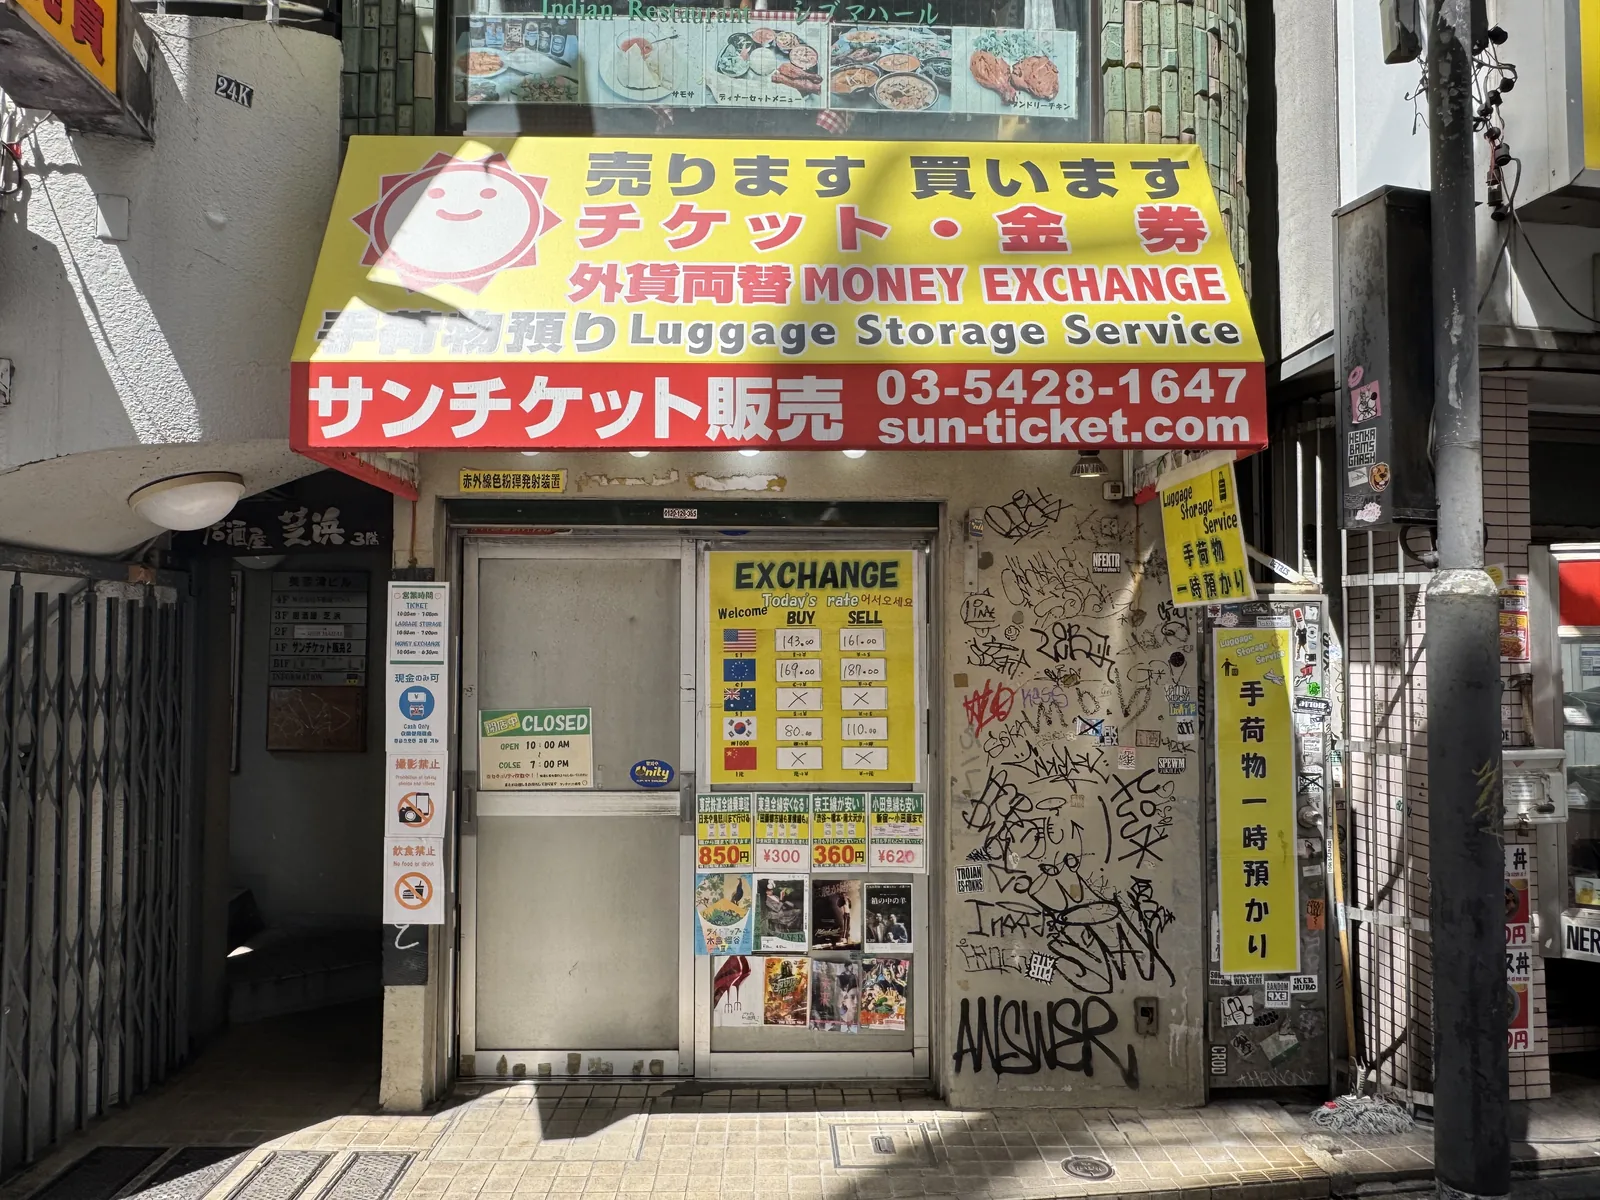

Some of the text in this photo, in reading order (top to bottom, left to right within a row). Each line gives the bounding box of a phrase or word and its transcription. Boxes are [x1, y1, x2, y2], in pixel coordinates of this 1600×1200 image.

[542, 0, 750, 24] Indian Restaurant
[215, 75, 252, 108] 24K
[585, 151, 1190, 200] 売ります 買います
[567, 262, 1226, 304] 外貨両替 MONEY EXCHANGE
[316, 310, 1241, 354] 手荷物預り Luggage Storage Service
[877, 368, 1248, 405] 03-5428-1647
[308, 374, 845, 442] サンチケット販売
[877, 407, 1251, 444] sun-ticket.com
[462, 473, 561, 490] 赤外線色粉弾発射装置
[1162, 486, 1193, 508] Luggage
[1180, 498, 1213, 520] Storage
[1203, 511, 1238, 535] Service
[1183, 537, 1225, 568] 手荷物
[734, 560, 899, 590] EXCHANGE
[1176, 568, 1246, 599] 一時預かり
[761, 592, 859, 609] Today's rate
[860, 593, 914, 608] 어서오세요
[274, 611, 289, 621] 3F
[718, 606, 768, 620] Welcome
[787, 610, 882, 624] BUY SELL
[274, 627, 289, 636] 2F
[275, 642, 288, 652] 1F
[782, 635, 814, 649] 143.00
[1219, 633, 1254, 648] Luggage
[1236, 642, 1269, 657] Storage
[1255, 650, 1286, 665] Service
[394, 673, 440, 683] 現金のみ可
[780, 662, 815, 678] 169.00
[522, 714, 588, 732] CLOSED
[500, 743, 519, 751] OPEN
[557, 741, 570, 749] AM
[395, 758, 441, 770] 撮影禁止
[499, 761, 521, 769] COLSE
[557, 759, 569, 768] PM
[1239, 680, 1269, 959] 手荷物一時預かり
[392, 845, 437, 857] 飲食禁止
[698, 845, 750, 865] 850円
[763, 848, 801, 863] ¥300
[814, 844, 865, 864] 360円
[878, 849, 915, 863] ¥620
[1266, 982, 1289, 991] RANDOM
[1211, 1046, 1227, 1075] CROD
